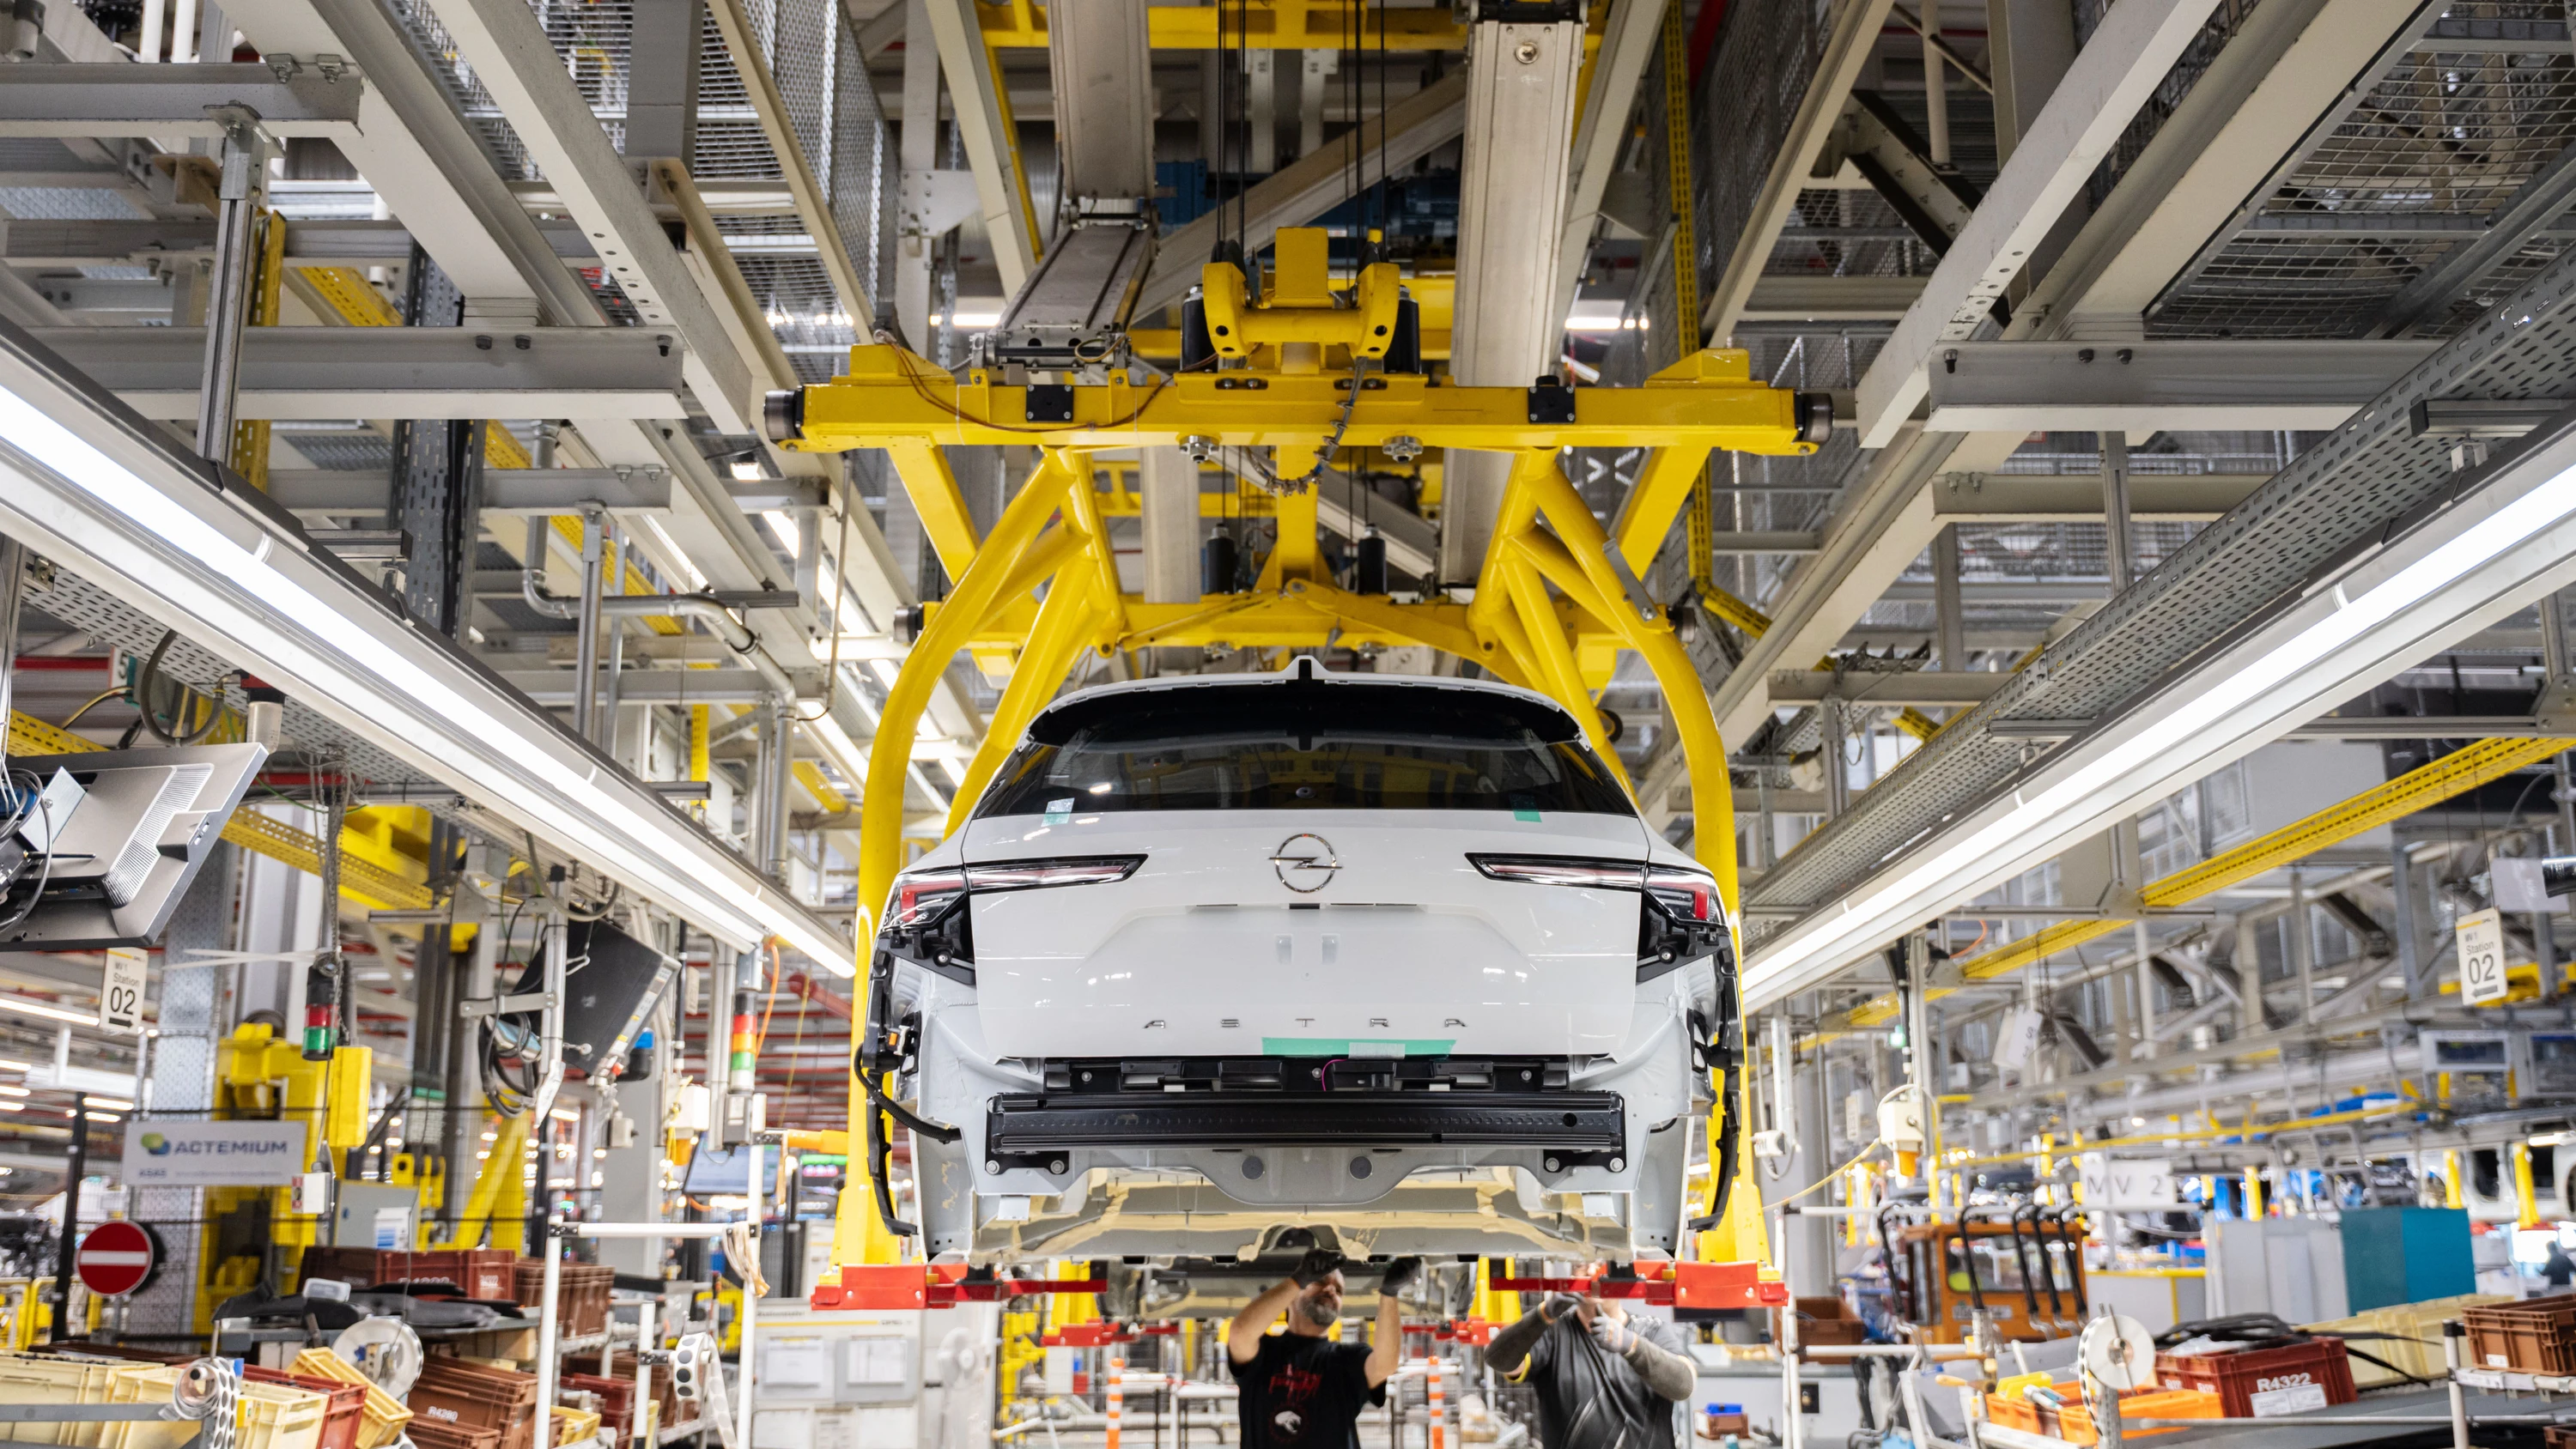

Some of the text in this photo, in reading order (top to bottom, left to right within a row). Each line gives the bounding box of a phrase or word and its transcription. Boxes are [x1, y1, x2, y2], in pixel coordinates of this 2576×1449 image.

[2466, 941, 2495, 955] Station
[2469, 954, 2496, 985] 02
[113, 973, 140, 987] Station
[111, 986, 136, 1016] 02
[174, 1140, 288, 1154] ACTEMIUM
[2150, 1174, 2162, 1196] 2
[2257, 1373, 2312, 1392] R4322
